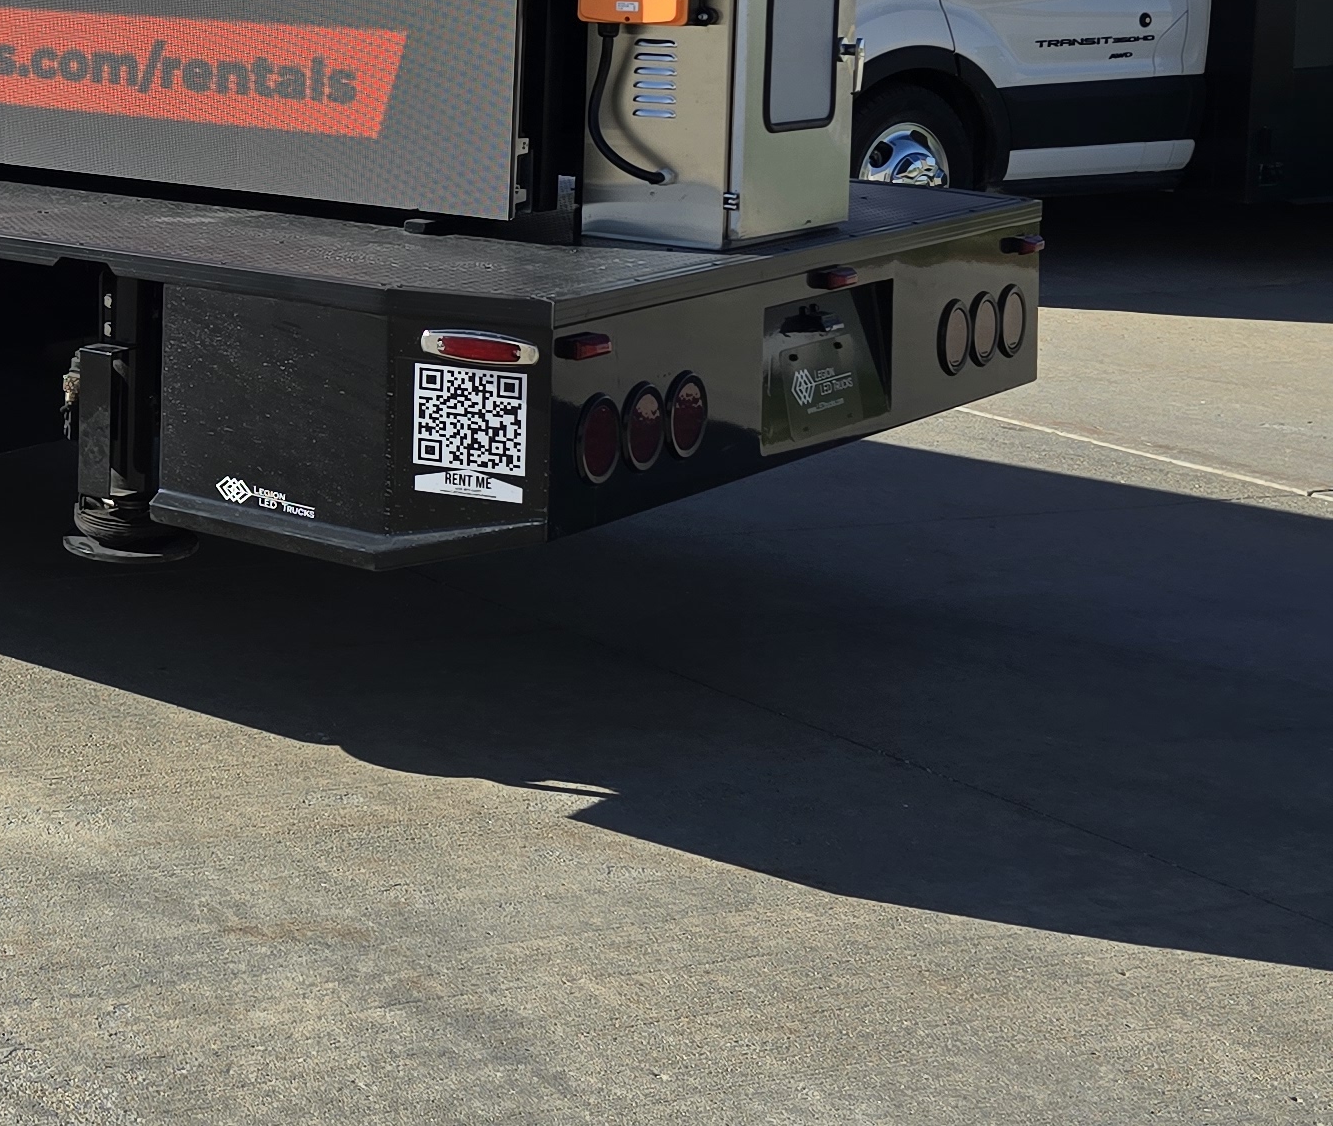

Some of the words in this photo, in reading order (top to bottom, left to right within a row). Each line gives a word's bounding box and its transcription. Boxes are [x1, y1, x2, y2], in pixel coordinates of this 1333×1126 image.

[1035, 36, 1113, 48] TRANSIT
[445, 472, 473, 487] RENT
[476, 476, 492, 489] ME
[253, 485, 286, 501] LEGION
[258, 498, 278, 510] LED
[281, 502, 315, 519] TRUCKS
